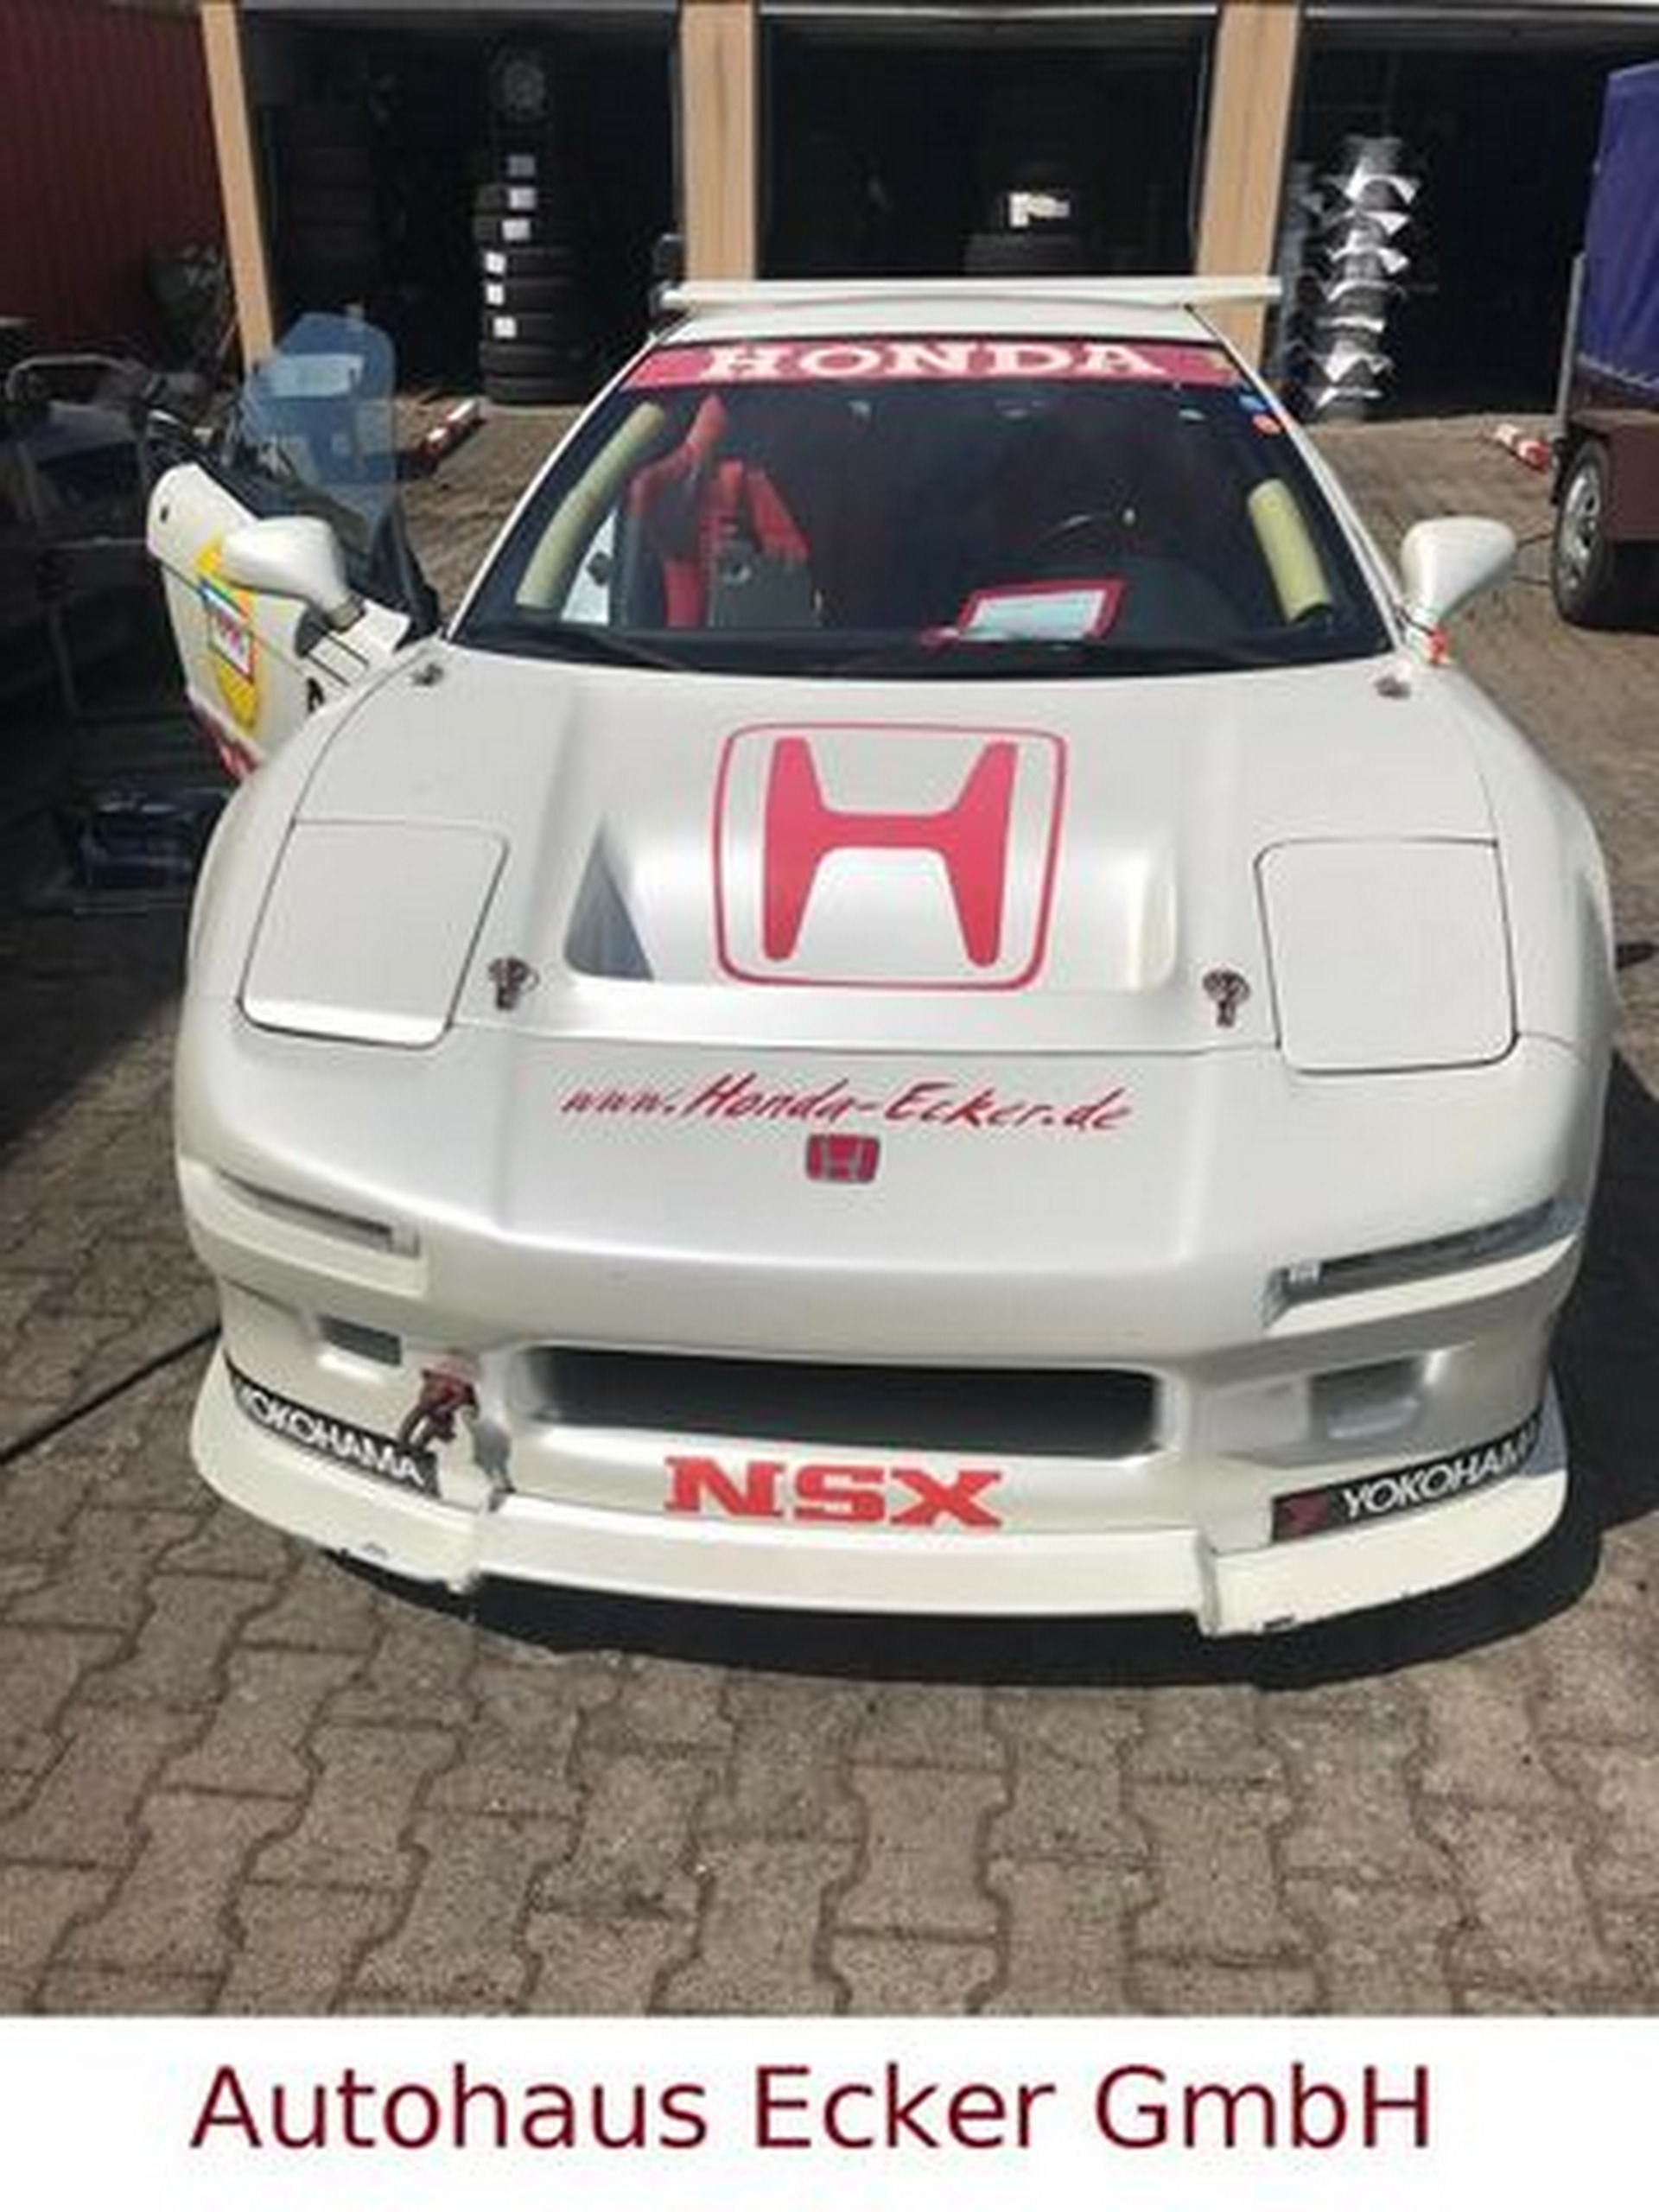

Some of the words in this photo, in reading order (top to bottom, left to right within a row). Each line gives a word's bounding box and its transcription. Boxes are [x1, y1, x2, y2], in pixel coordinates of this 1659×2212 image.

[699, 342, 1167, 378] HONDA
[560, 1071, 1133, 1131] www.Honda-Ecker.de
[664, 1455, 1003, 1529] NSX
